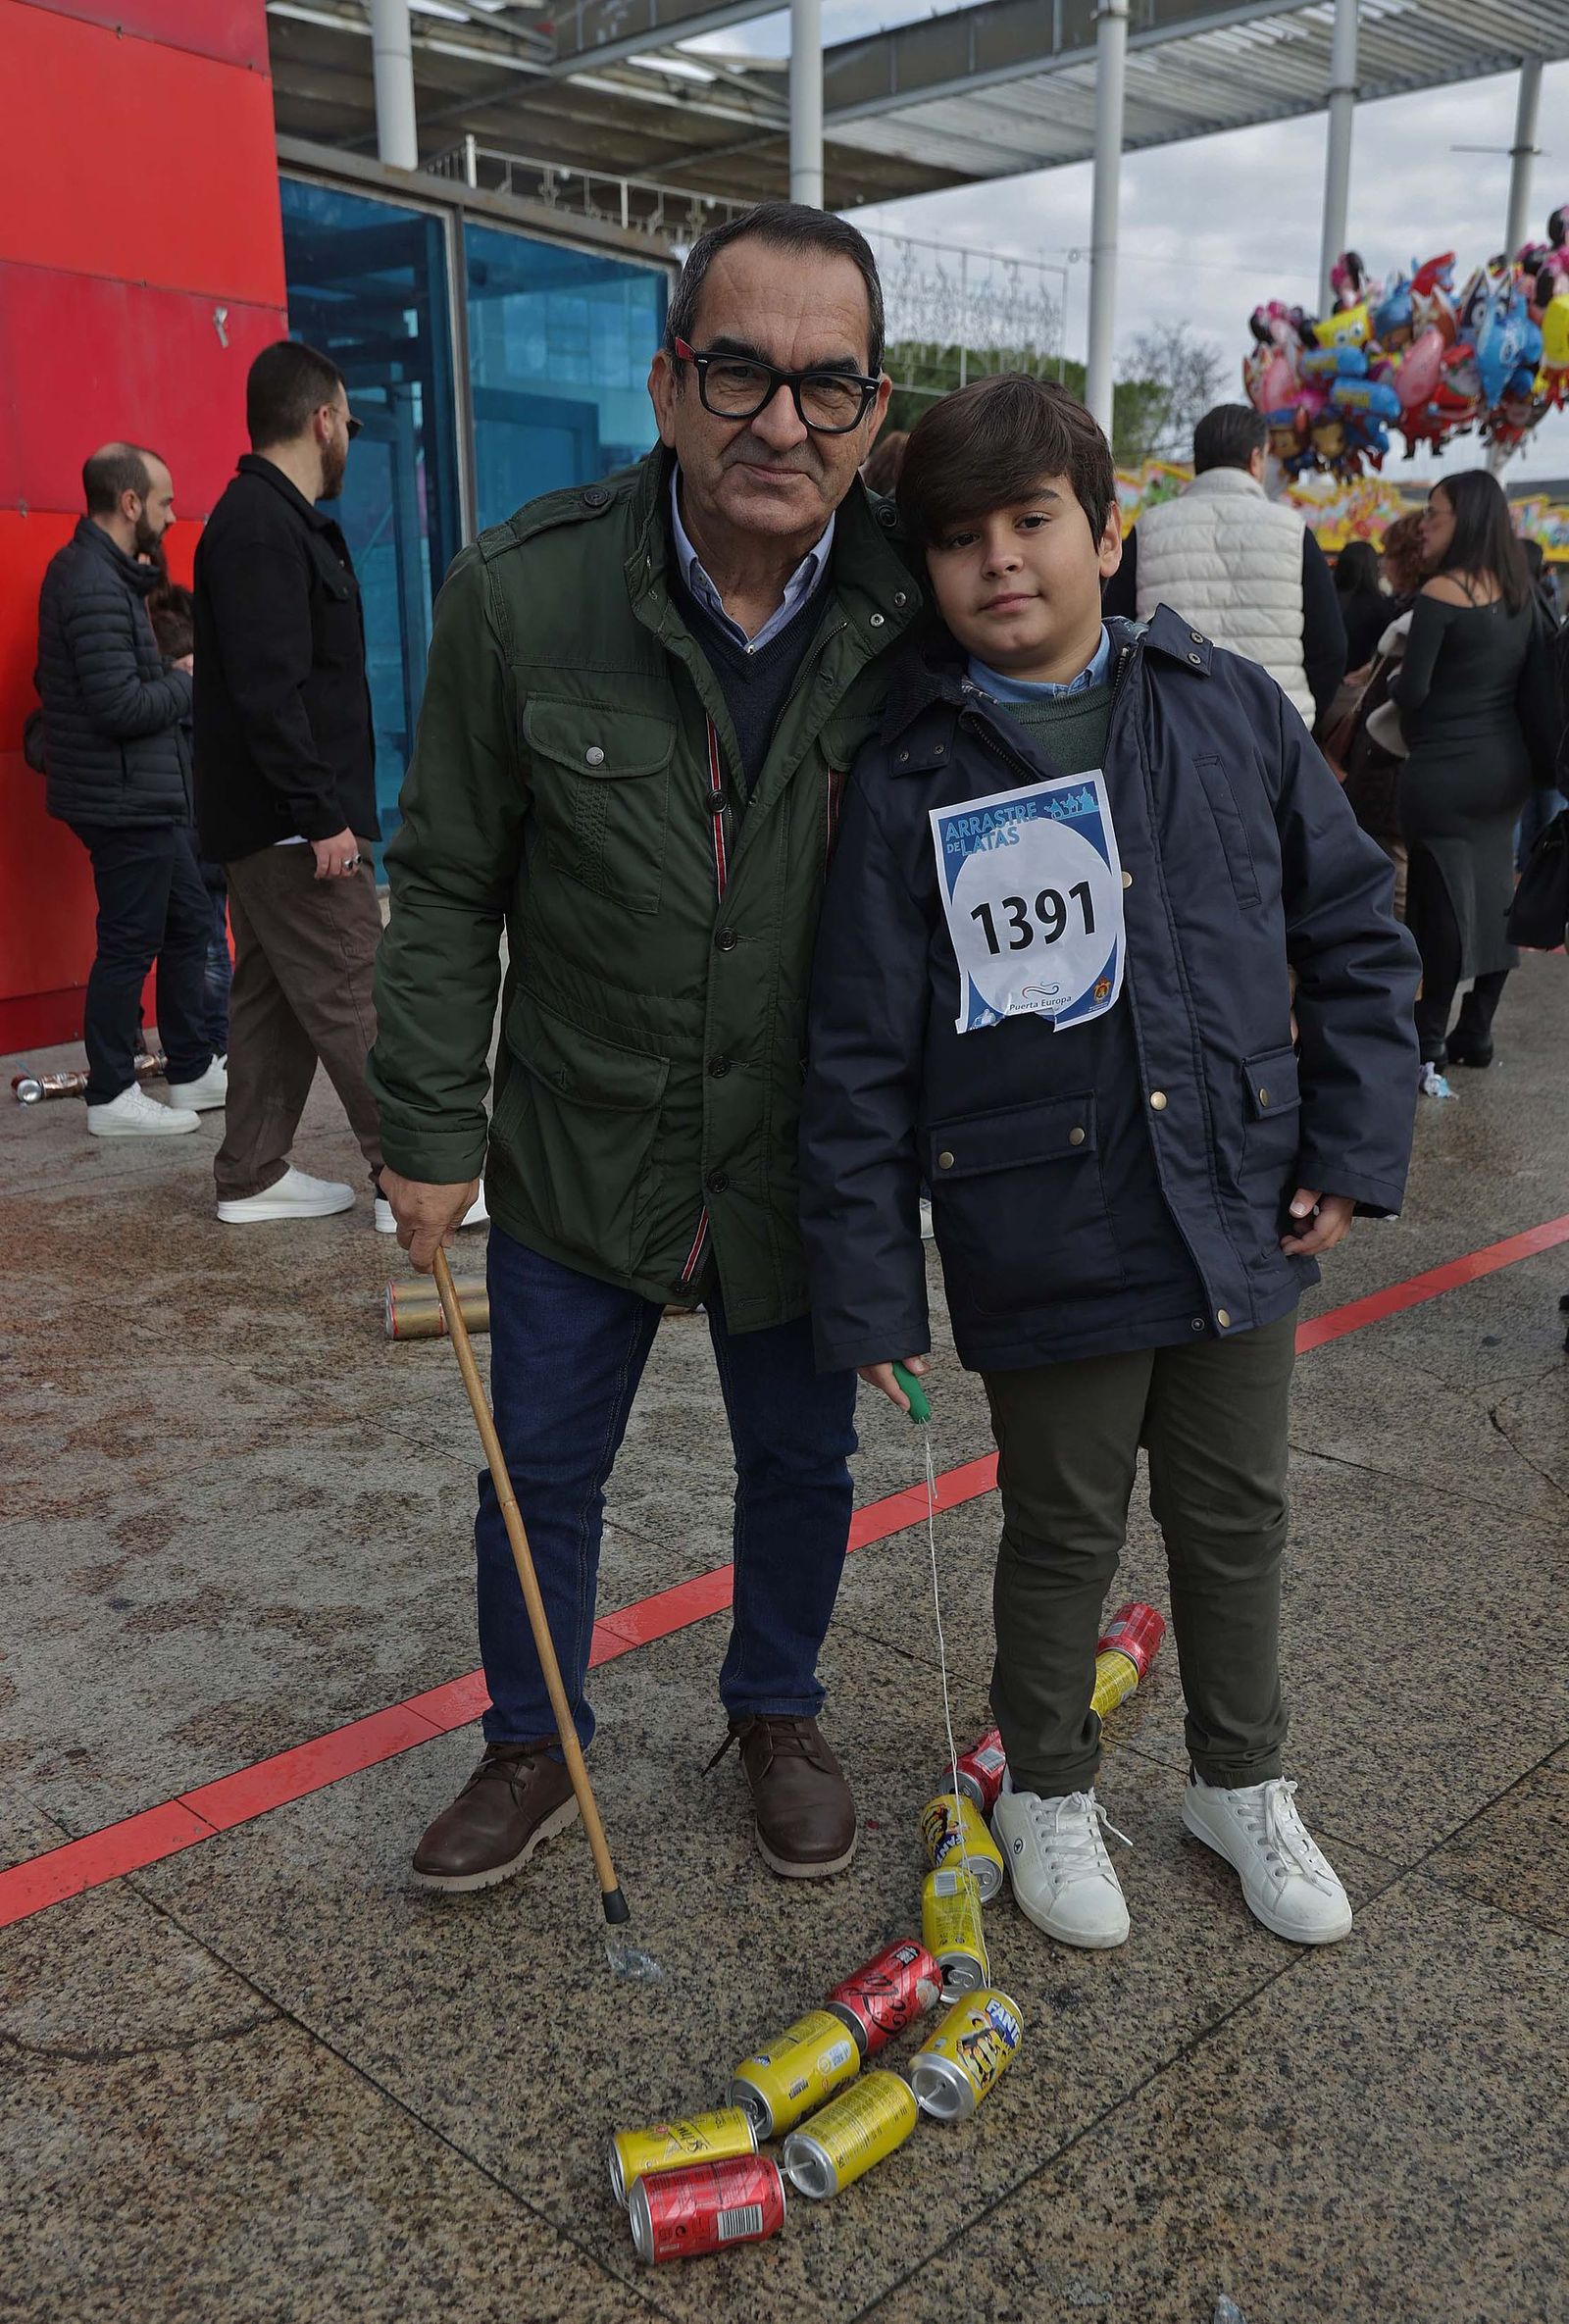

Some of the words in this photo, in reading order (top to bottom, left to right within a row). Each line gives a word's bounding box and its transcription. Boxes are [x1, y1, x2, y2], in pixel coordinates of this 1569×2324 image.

[945, 801, 1038, 842] ARRASTRE
[946, 841, 961, 854] DE
[960, 826, 1021, 857] LATAS
[969, 881, 1096, 956] 1391
[1009, 1002, 1038, 1011] Puerta
[1040, 996, 1072, 1006] Europa
